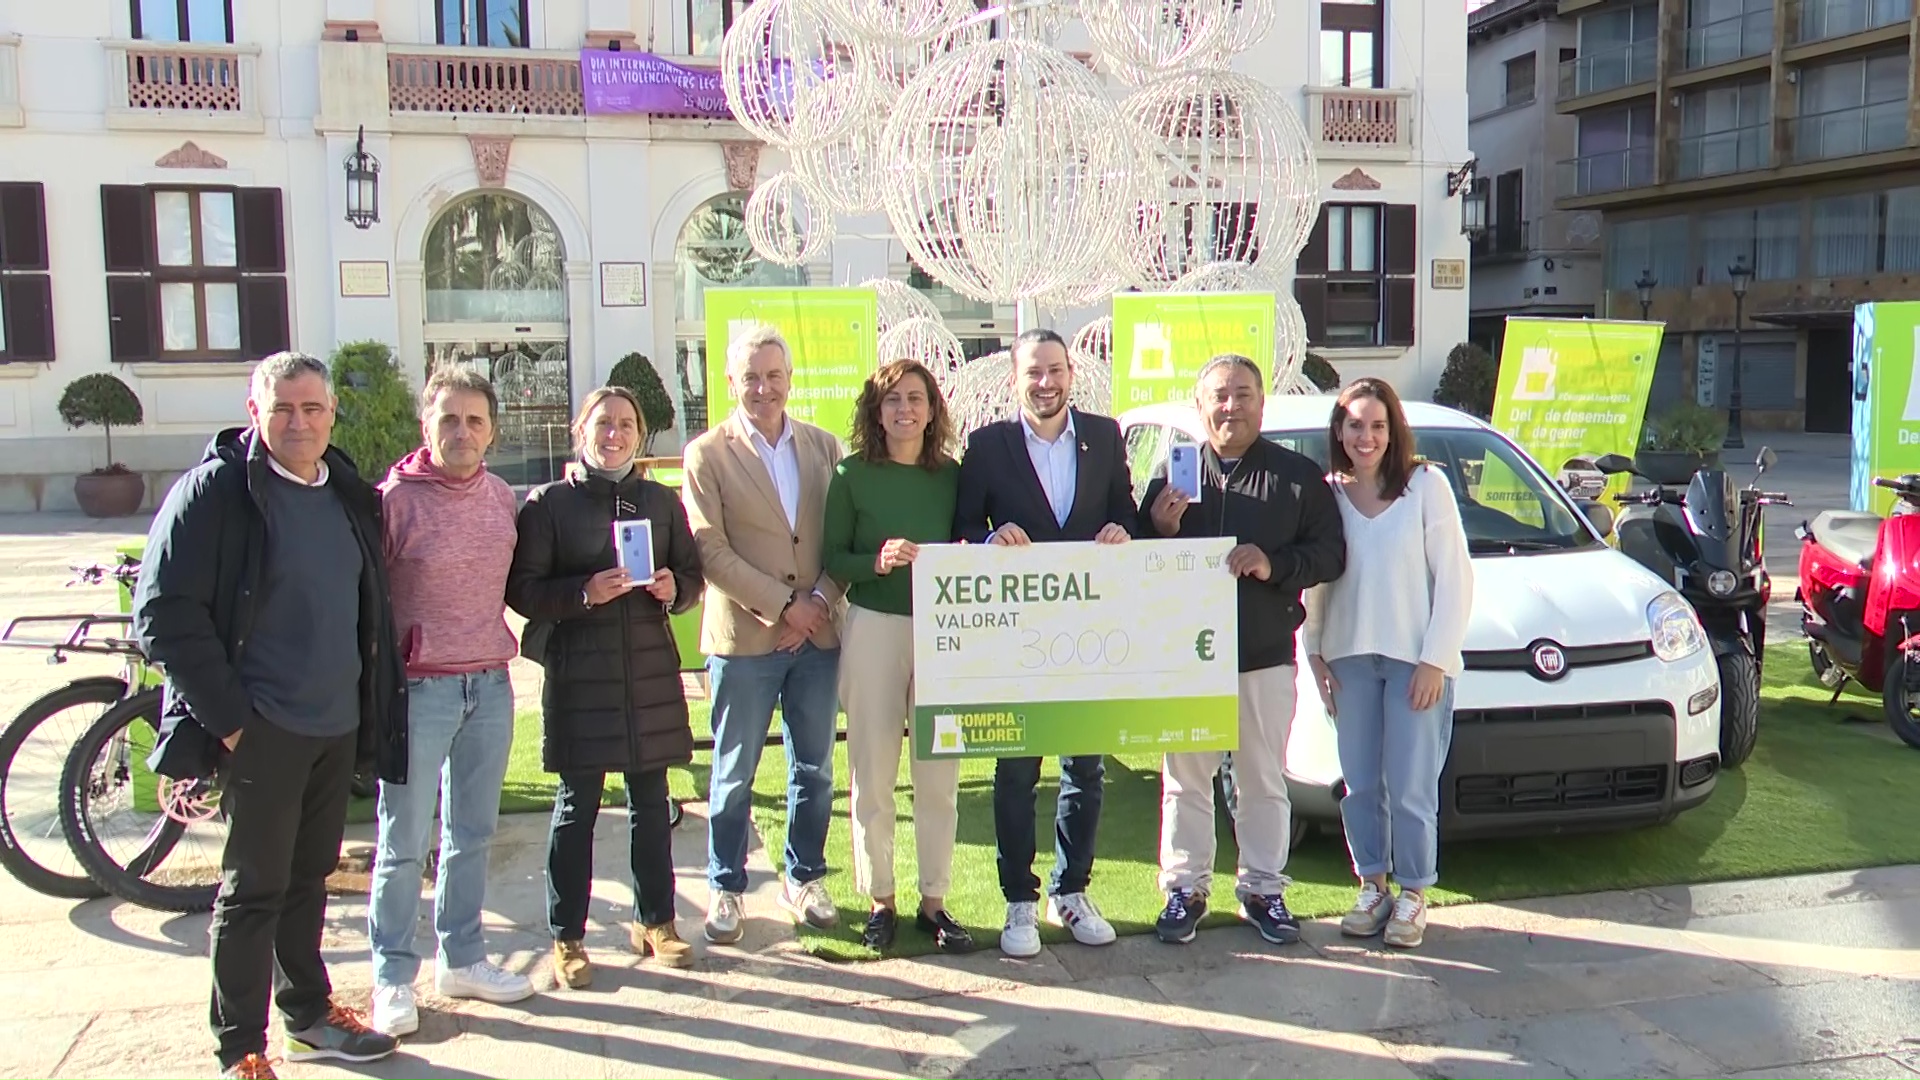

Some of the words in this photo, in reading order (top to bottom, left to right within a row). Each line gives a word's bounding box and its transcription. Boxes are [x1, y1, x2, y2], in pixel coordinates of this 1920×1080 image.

[590, 57, 606, 70] DIA
[591, 71, 602, 84] DE
[605, 71, 618, 85] LA
[671, 74, 695, 89] VERS
[697, 96, 729, 112] NOVE
[788, 383, 859, 400] desembre
[1130, 386, 1153, 402] Del
[1167, 385, 1184, 401] de
[785, 405, 818, 418] ener
[1510, 407, 1532, 422] Del
[1545, 407, 1561, 422] de
[1562, 408, 1627, 424] desembre
[1532, 425, 1546, 439] de
[1549, 428, 1587, 442] gener
[1898, 428, 1920, 445] De
[934, 575, 992, 605] XEC
[1001, 572, 1101, 604] REGAL
[935, 611, 1020, 629] VALORAT
[936, 636, 961, 651] EN
[1195, 628, 1216, 662] €
[955, 712, 1016, 728] COMPRA
[970, 728, 1023, 743] LLORET
